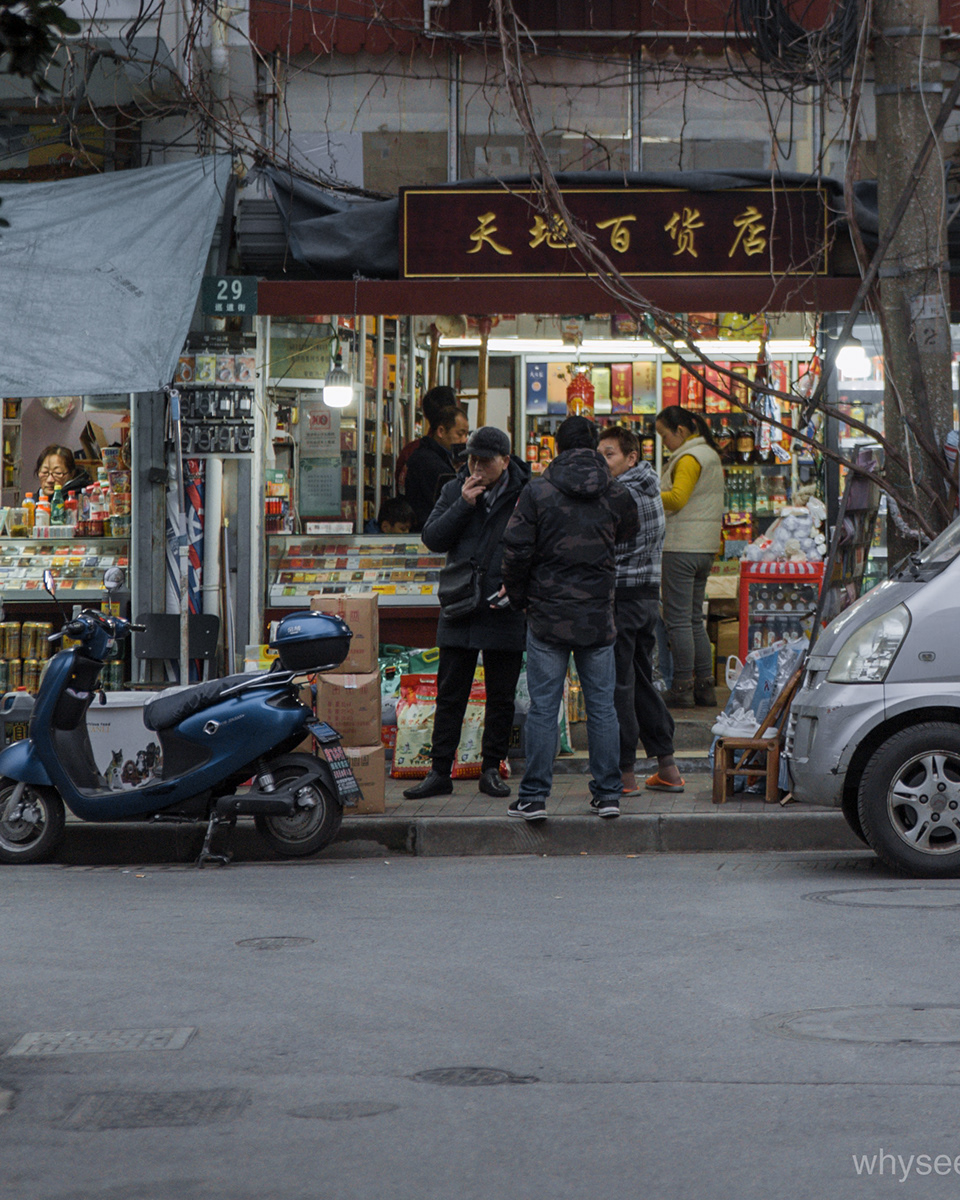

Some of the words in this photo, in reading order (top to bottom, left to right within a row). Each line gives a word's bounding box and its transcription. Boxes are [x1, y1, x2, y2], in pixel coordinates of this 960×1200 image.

[466, 206, 767, 258] 天地百货店
[217, 279, 243, 300] 29
